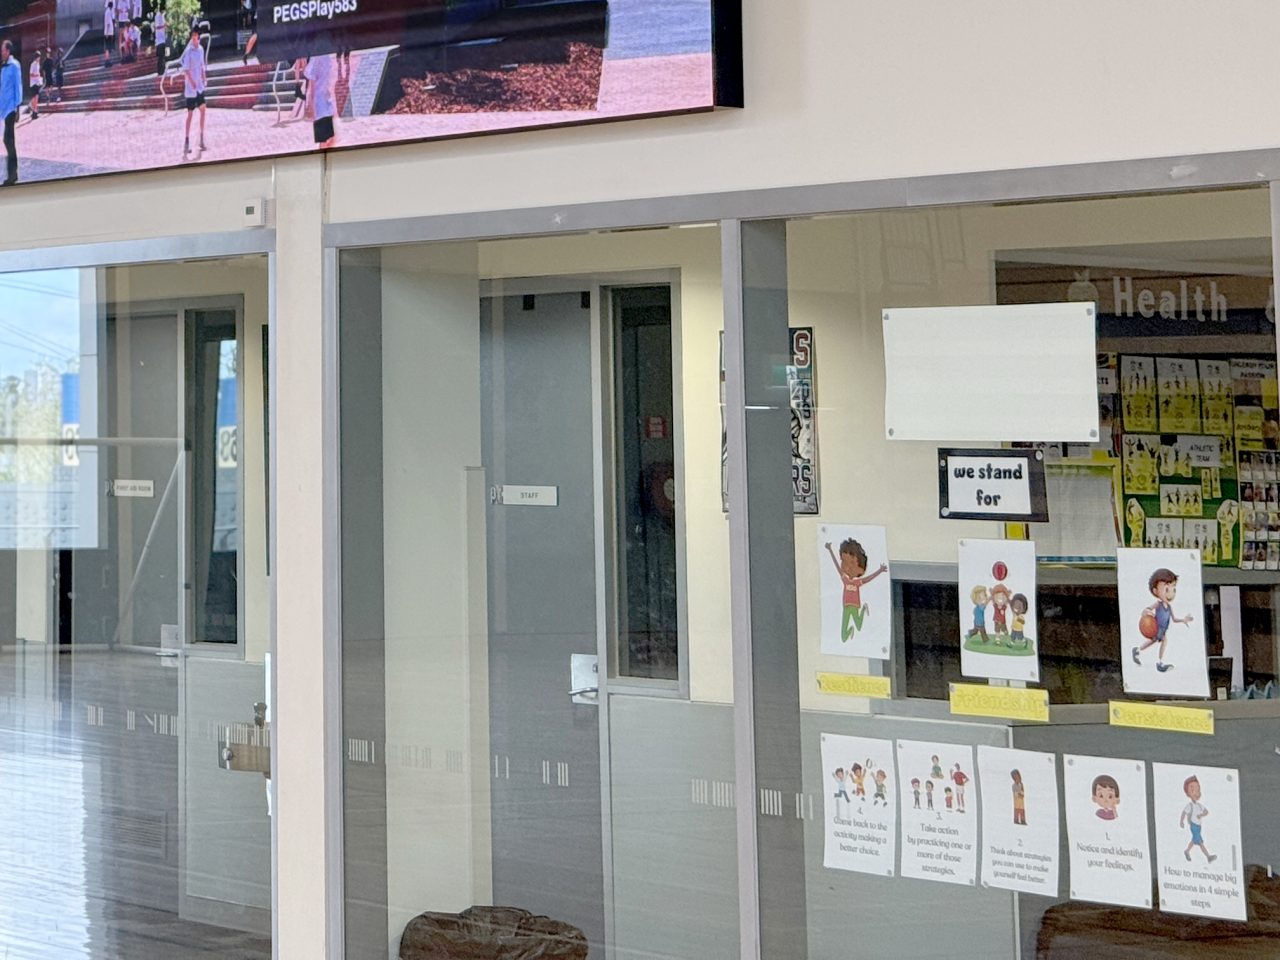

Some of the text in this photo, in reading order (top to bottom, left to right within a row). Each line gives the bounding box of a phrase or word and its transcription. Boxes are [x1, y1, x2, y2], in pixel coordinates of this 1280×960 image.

[1113, 276, 1228, 323] Health
[953, 463, 1023, 479] we stand
[976, 489, 1001, 506] for
[853, 818, 869, 828] back
[877, 822, 888, 831] the
[920, 823, 959, 835] Take action
[833, 831, 857, 841] activity
[858, 834, 881, 845] making
[907, 834, 916, 845] by
[917, 851, 962, 862] more of those
[990, 846, 1006, 855] Think
[1007, 849, 1023, 857] about
[1077, 842, 1143, 859] Notice and identify
[1087, 859, 1104, 868] your
[993, 870, 1016, 879] yourself
[1017, 872, 1027, 880] feel
[1163, 865, 1237, 885] How to manage big
[1163, 881, 1240, 899] emotions in 4 simple
[1191, 899, 1211, 909] steps
